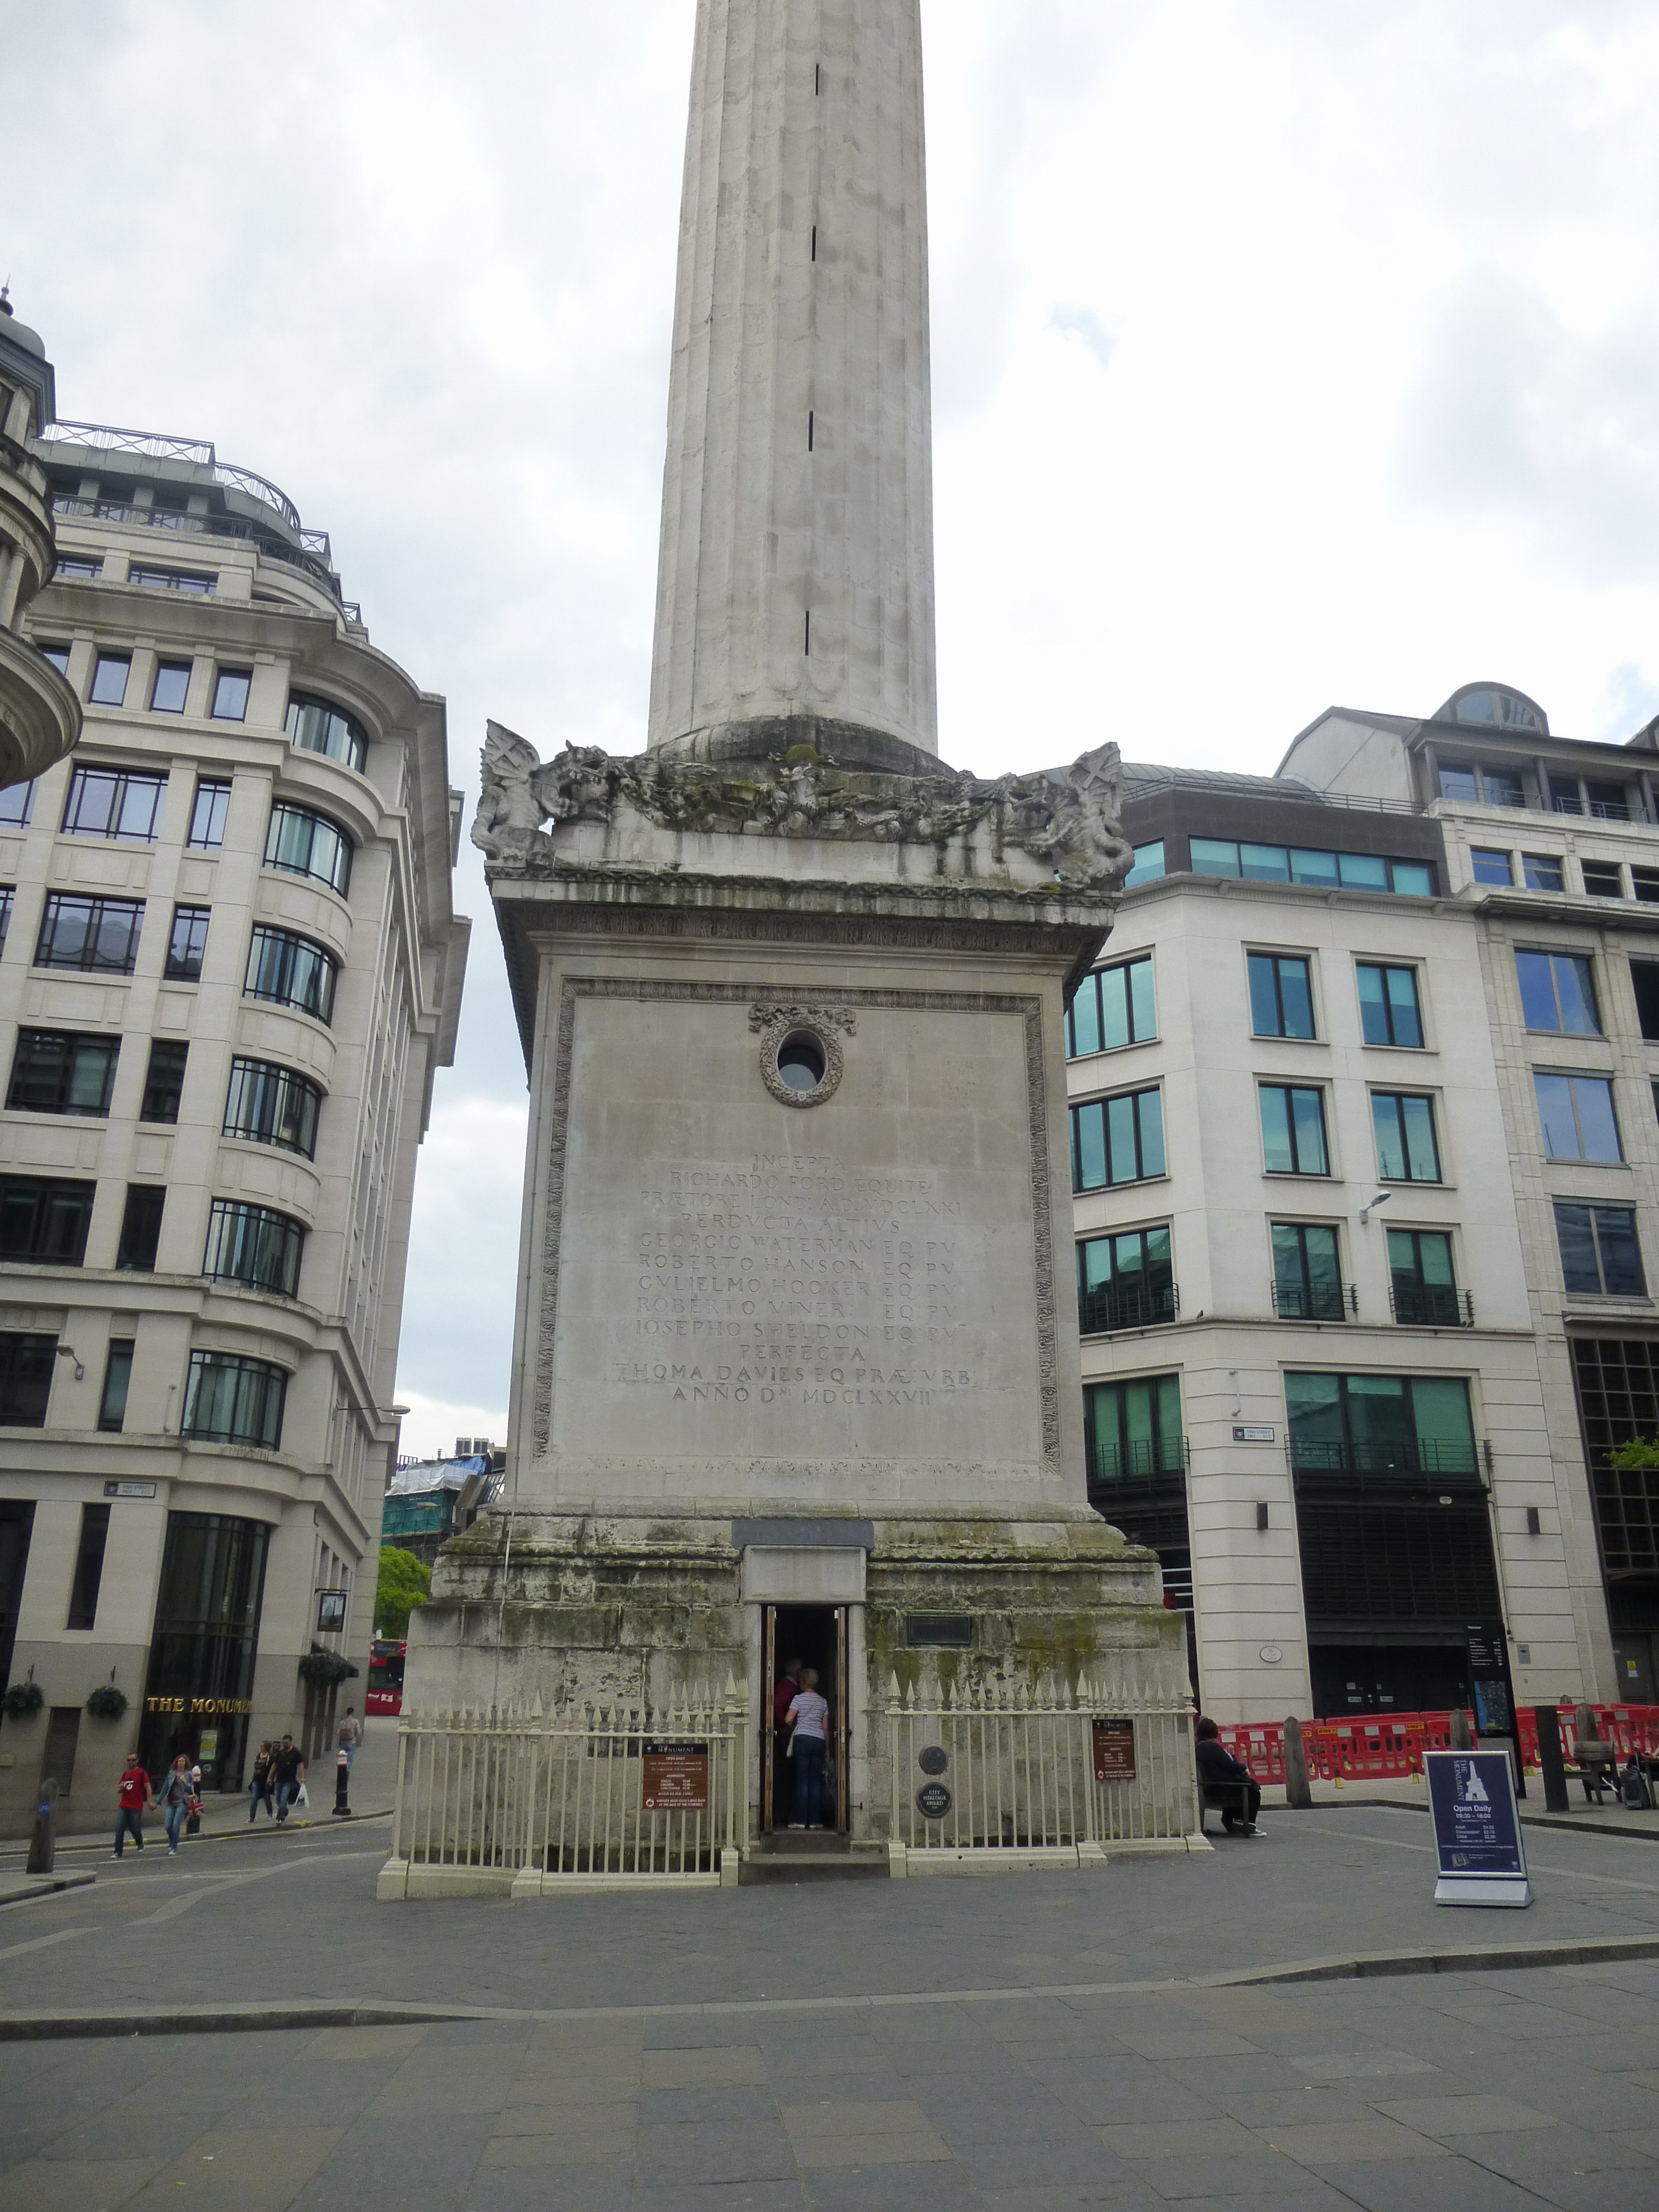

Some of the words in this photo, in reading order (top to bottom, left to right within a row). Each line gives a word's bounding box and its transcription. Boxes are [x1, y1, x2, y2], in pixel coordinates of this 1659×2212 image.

[670, 1171, 779, 1189] RICHARDO
[789, 1176, 844, 1191] FORD
[641, 1232, 742, 1250] GEORGIO
[751, 1236, 873, 1254] WATERMAN
[640, 1254, 754, 1271] ROBERTO
[764, 1258, 864, 1274] HANSON
[772, 1279, 869, 1296] HOOKER
[637, 1297, 756, 1315] ROBERTO
[753, 1322, 868, 1339] SHELDON
[740, 1344, 865, 1361] PERFECTA
[615, 1363, 703, 1381] THOMA
[717, 1366, 804, 1381] DAVIES
[672, 1386, 749, 1402] ANNO
[803, 1389, 930, 1405] MDCLXXVII
[147, 1697, 184, 1712] THE
[1453, 1760, 1465, 1801] MONUMENT
